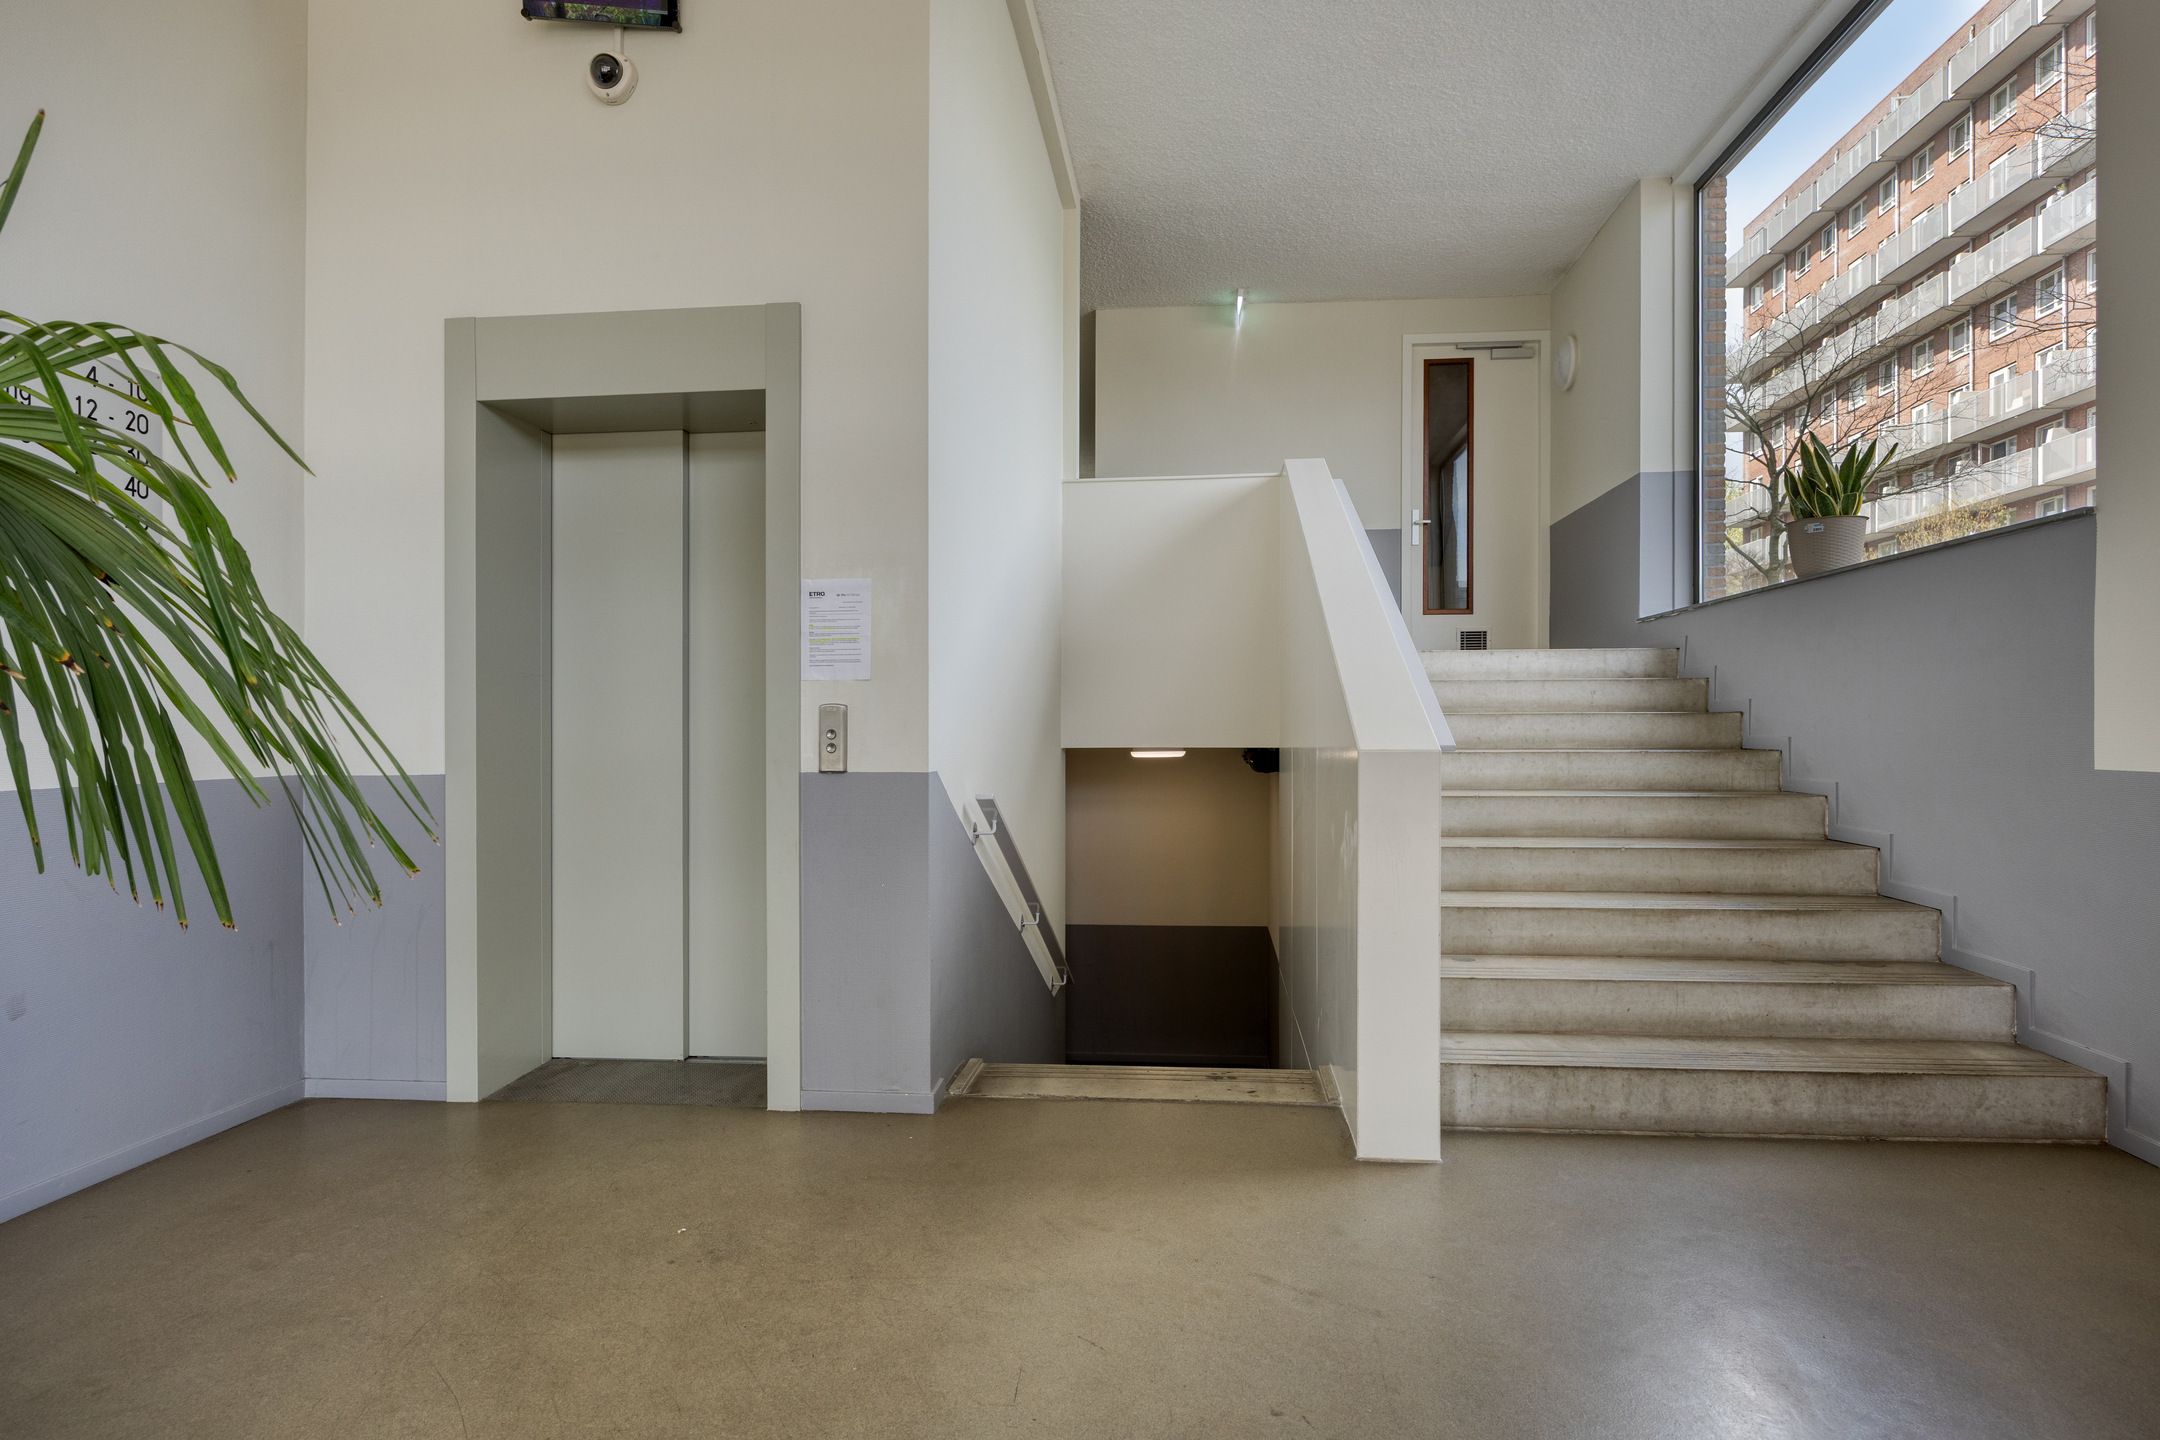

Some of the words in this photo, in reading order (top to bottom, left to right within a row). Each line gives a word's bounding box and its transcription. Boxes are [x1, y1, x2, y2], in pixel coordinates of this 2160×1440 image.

[86, 366, 99, 387] 4
[75, 395, 97, 421] 12
[125, 410, 149, 434] 20
[124, 476, 149, 499] 40
